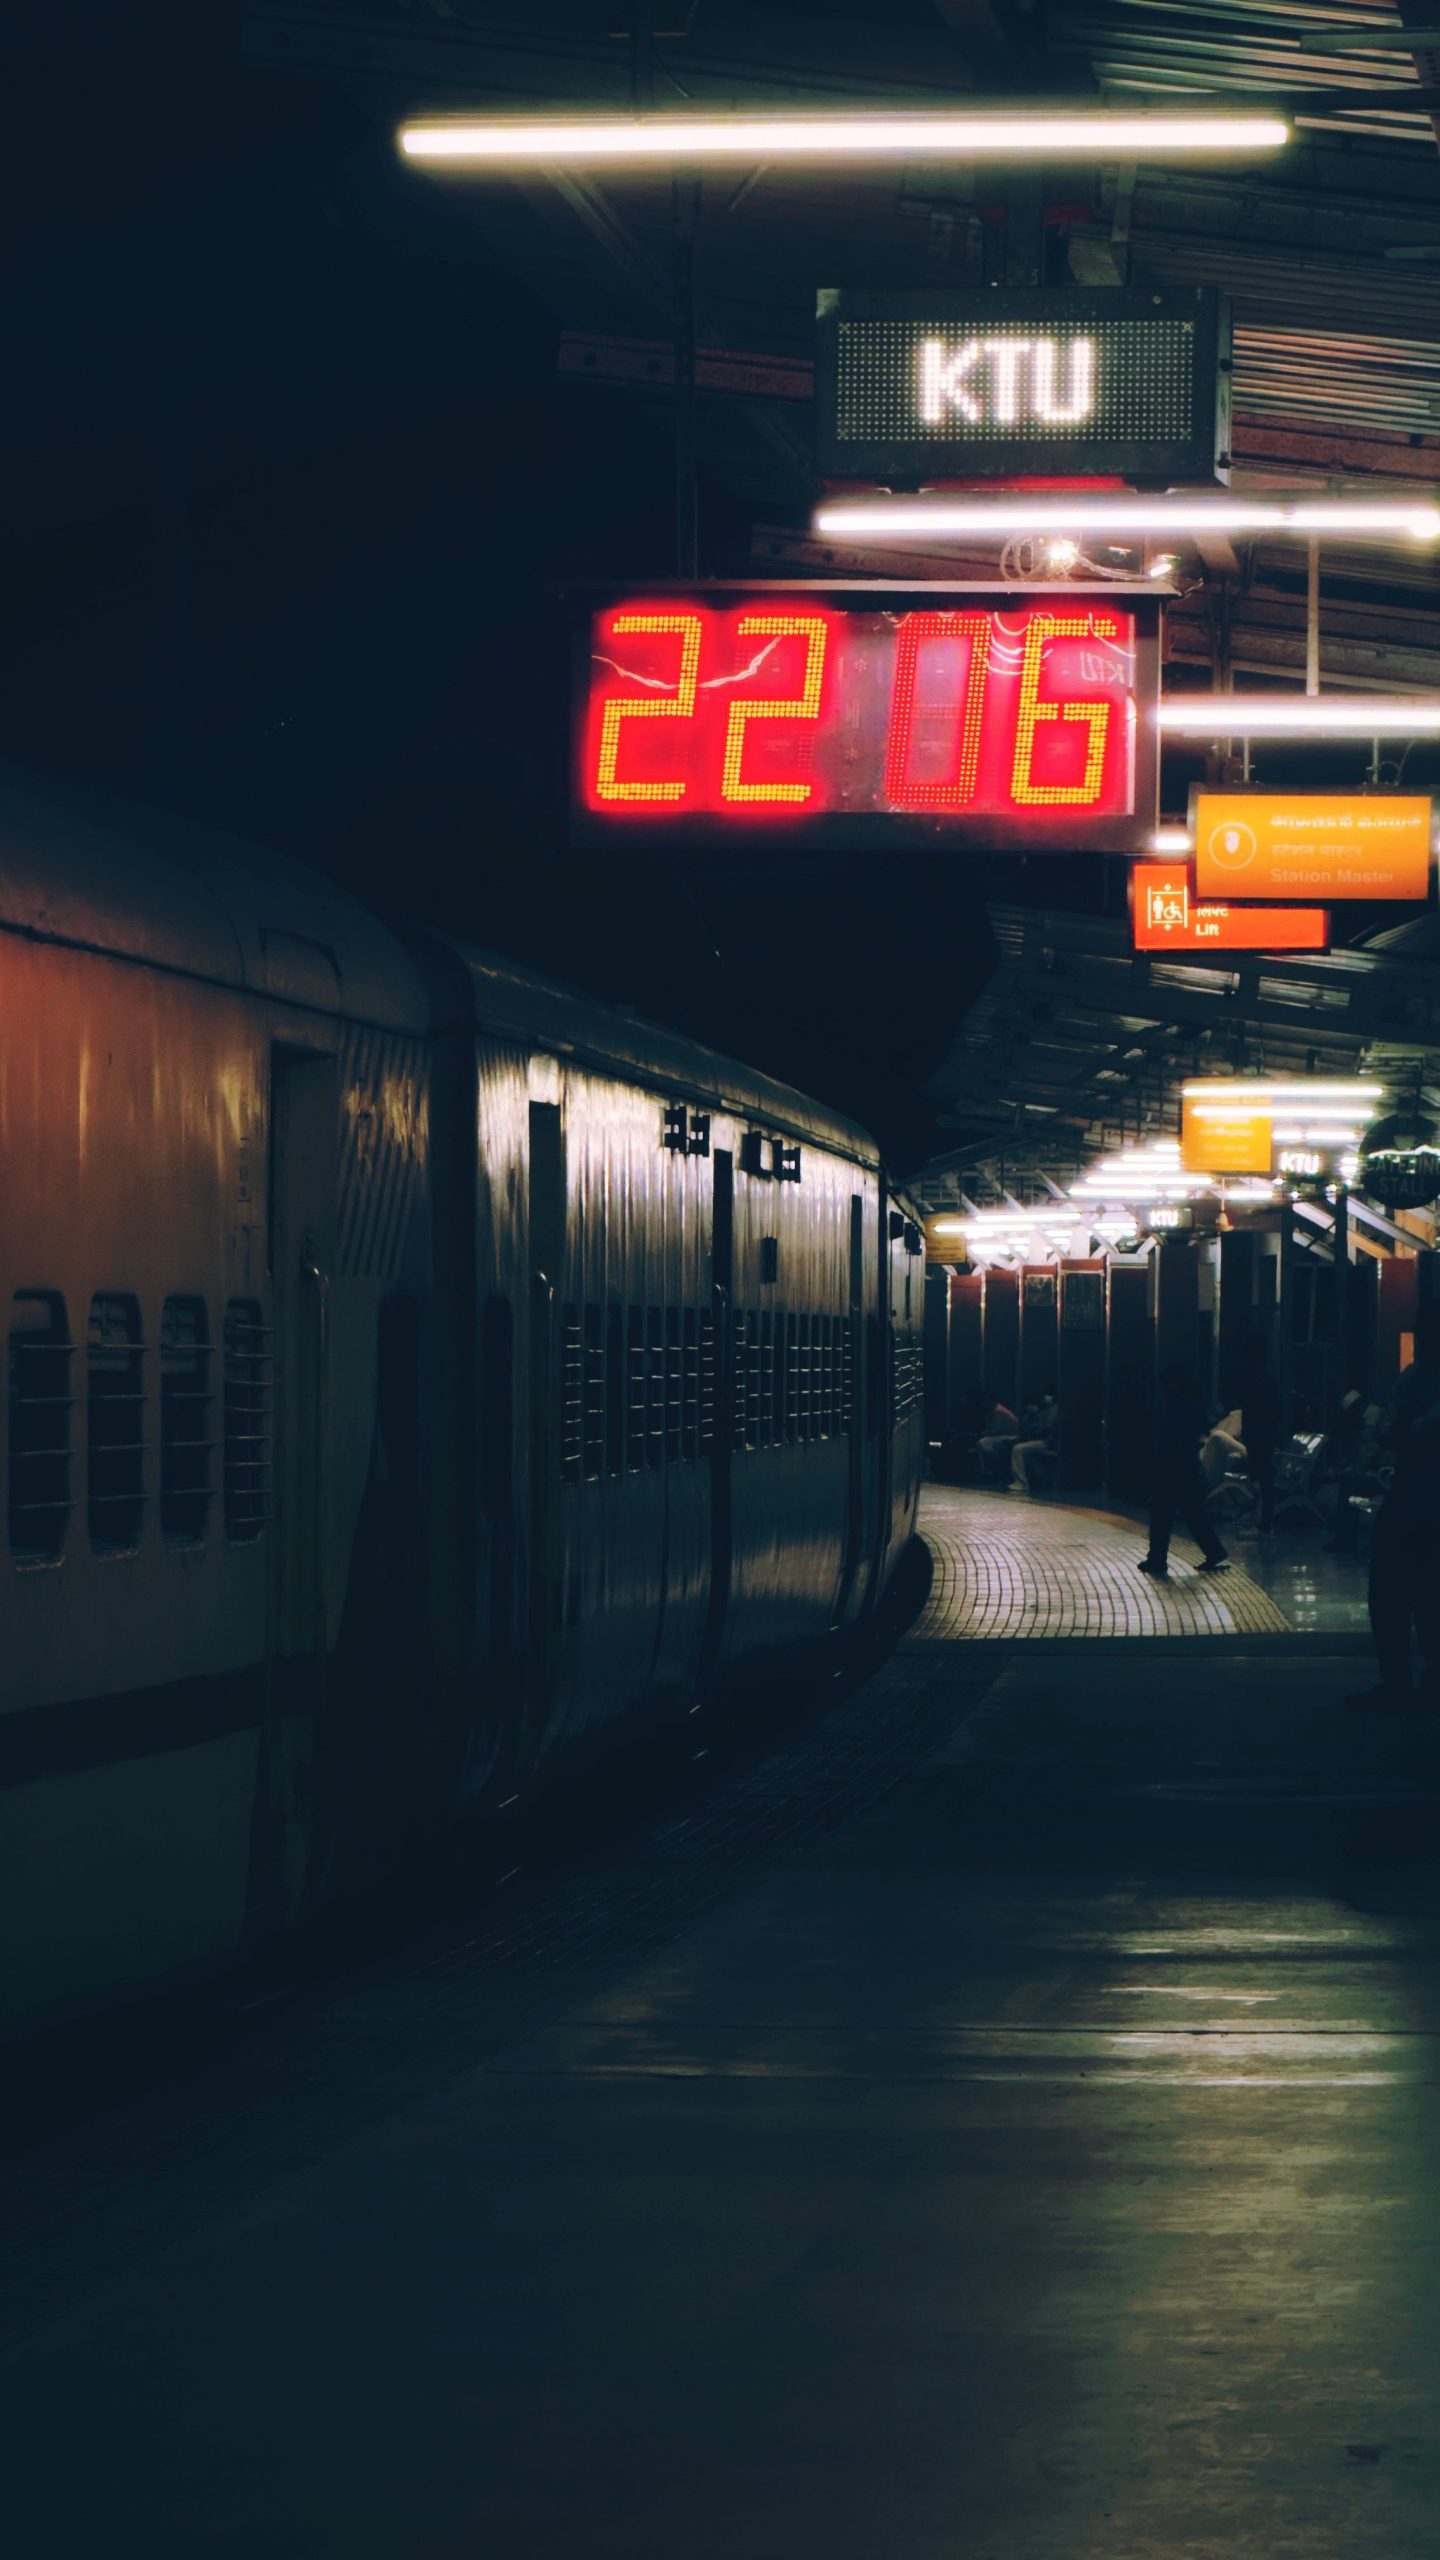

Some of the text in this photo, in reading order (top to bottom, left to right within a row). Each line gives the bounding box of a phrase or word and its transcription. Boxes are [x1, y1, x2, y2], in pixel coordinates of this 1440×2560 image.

[921, 339, 1097, 423] KTU
[1270, 868, 1393, 884] Station Master
[1196, 923, 1220, 937] Lift
[1280, 1152, 1320, 1174] KTU
[1379, 1176, 1427, 1197] STALL
[1150, 1209, 1179, 1227] KTU
